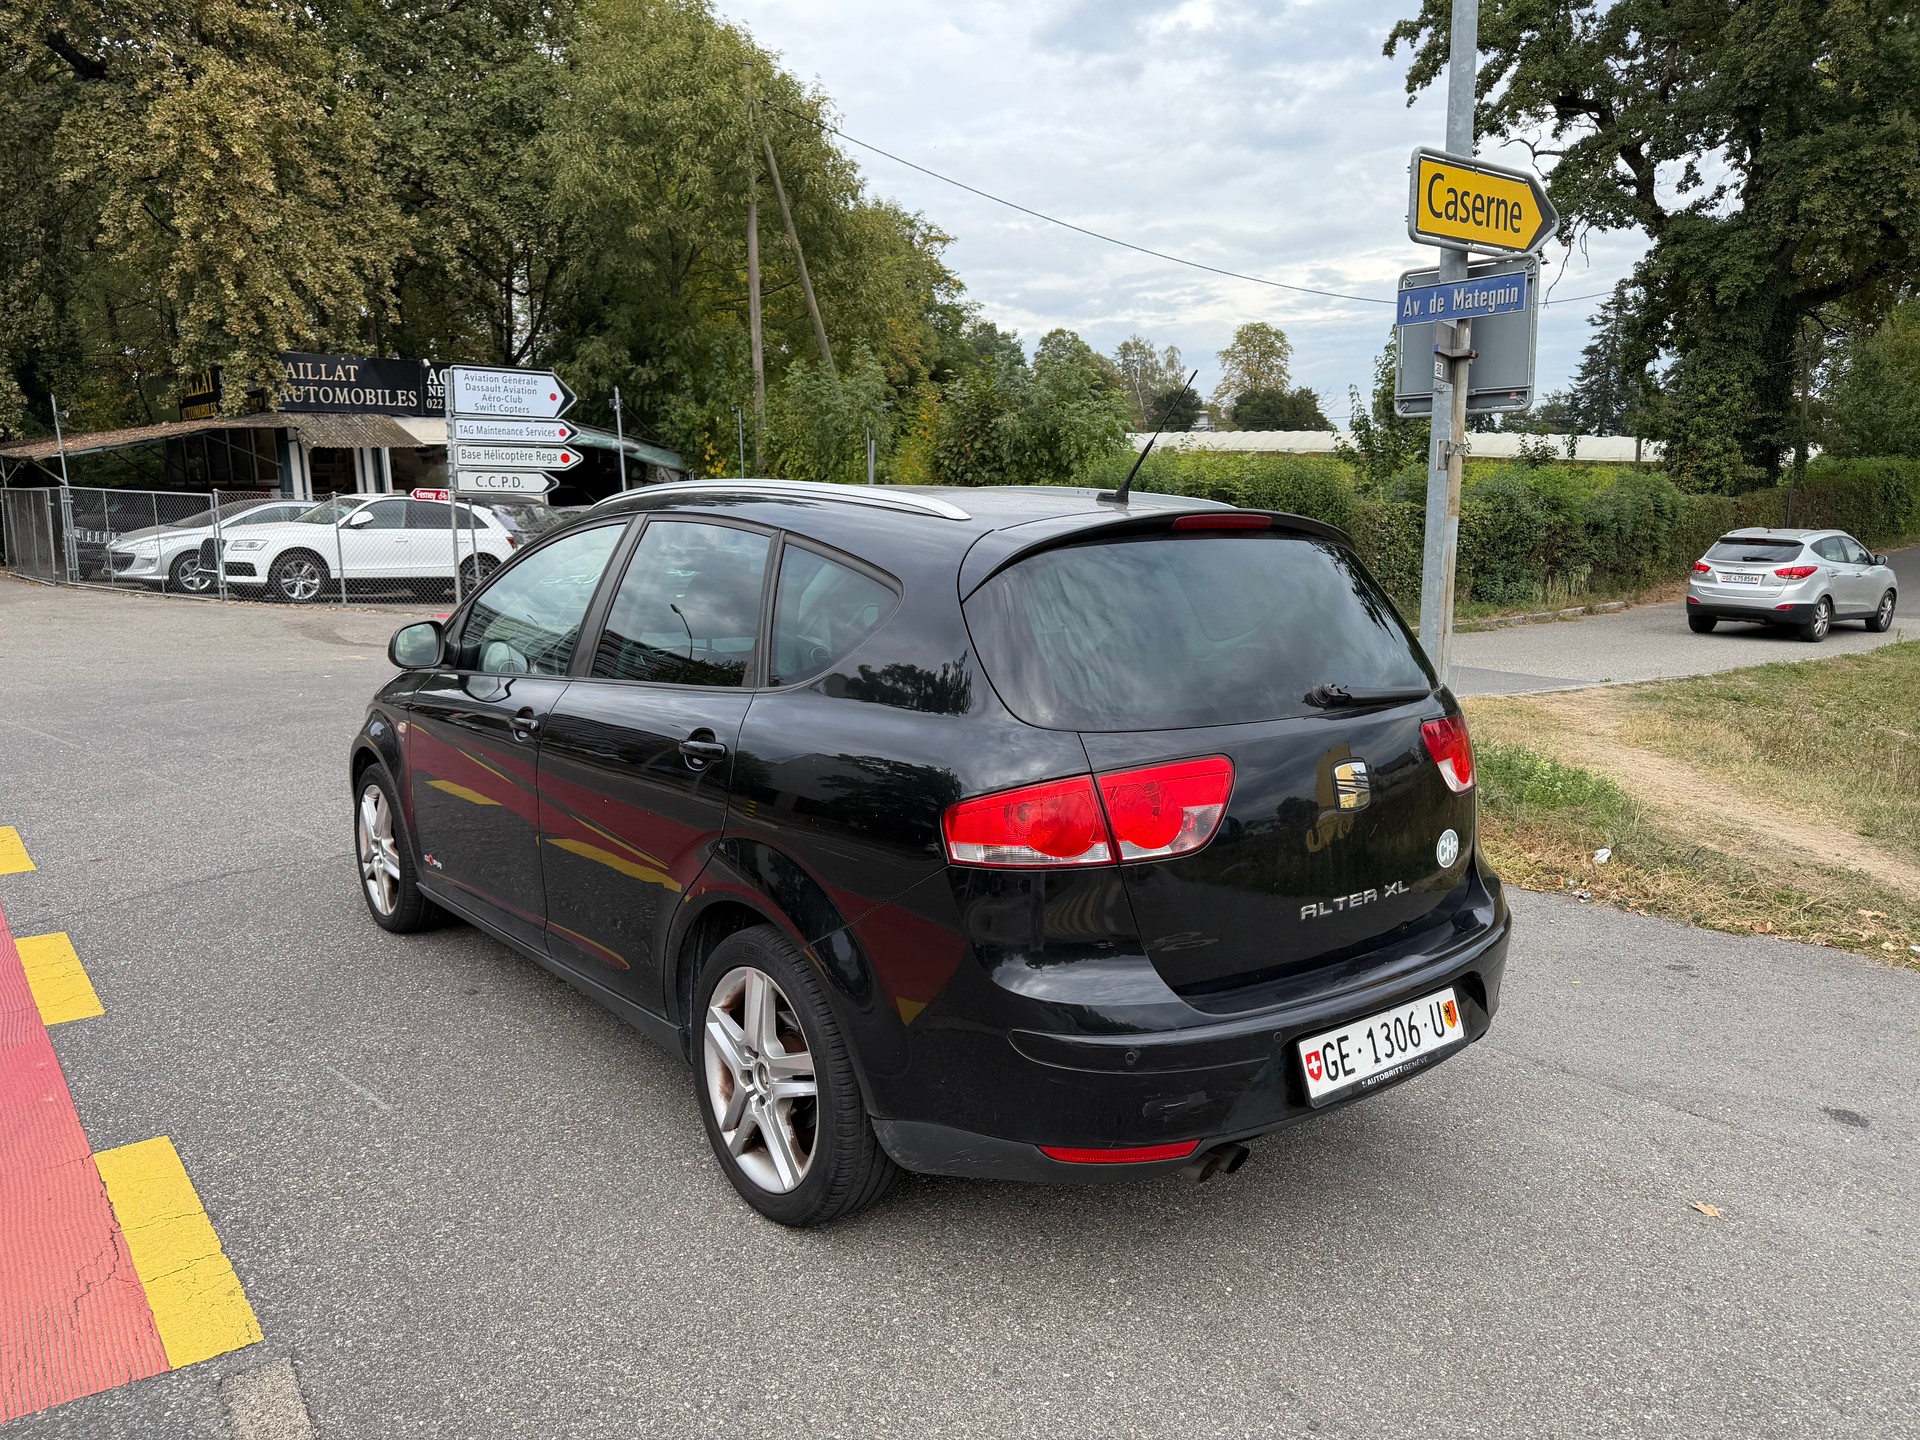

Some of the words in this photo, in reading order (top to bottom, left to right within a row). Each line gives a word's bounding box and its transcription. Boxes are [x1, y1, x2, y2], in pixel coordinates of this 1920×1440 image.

[1427, 172, 1523, 233] Caserne
[1403, 295, 1424, 318] Av.
[1429, 291, 1445, 314] de
[1453, 284, 1519, 313] Mategnin
[464, 373, 499, 384] Aviation
[501, 375, 538, 386] Générale
[465, 383, 501, 393] Dassault
[503, 385, 537, 395] Aviation
[278, 386, 418, 407] AUTOMOBILES
[481, 394, 523, 404] Aéro-Club
[426, 398, 444, 409] 022
[474, 402, 497, 412] Swift
[498, 403, 530, 414] Copters
[459, 425, 474, 434] TAG
[476, 426, 524, 436] Maintenance
[525, 427, 556, 437] Services
[461, 449, 482, 459] Base
[484, 449, 533, 464] Hélicoptère
[536, 451, 558, 464] Rega
[475, 476, 525, 488] C.C.P.D.
[416, 490, 437, 501] Ferney
[1384, 880, 1410, 898] XL
